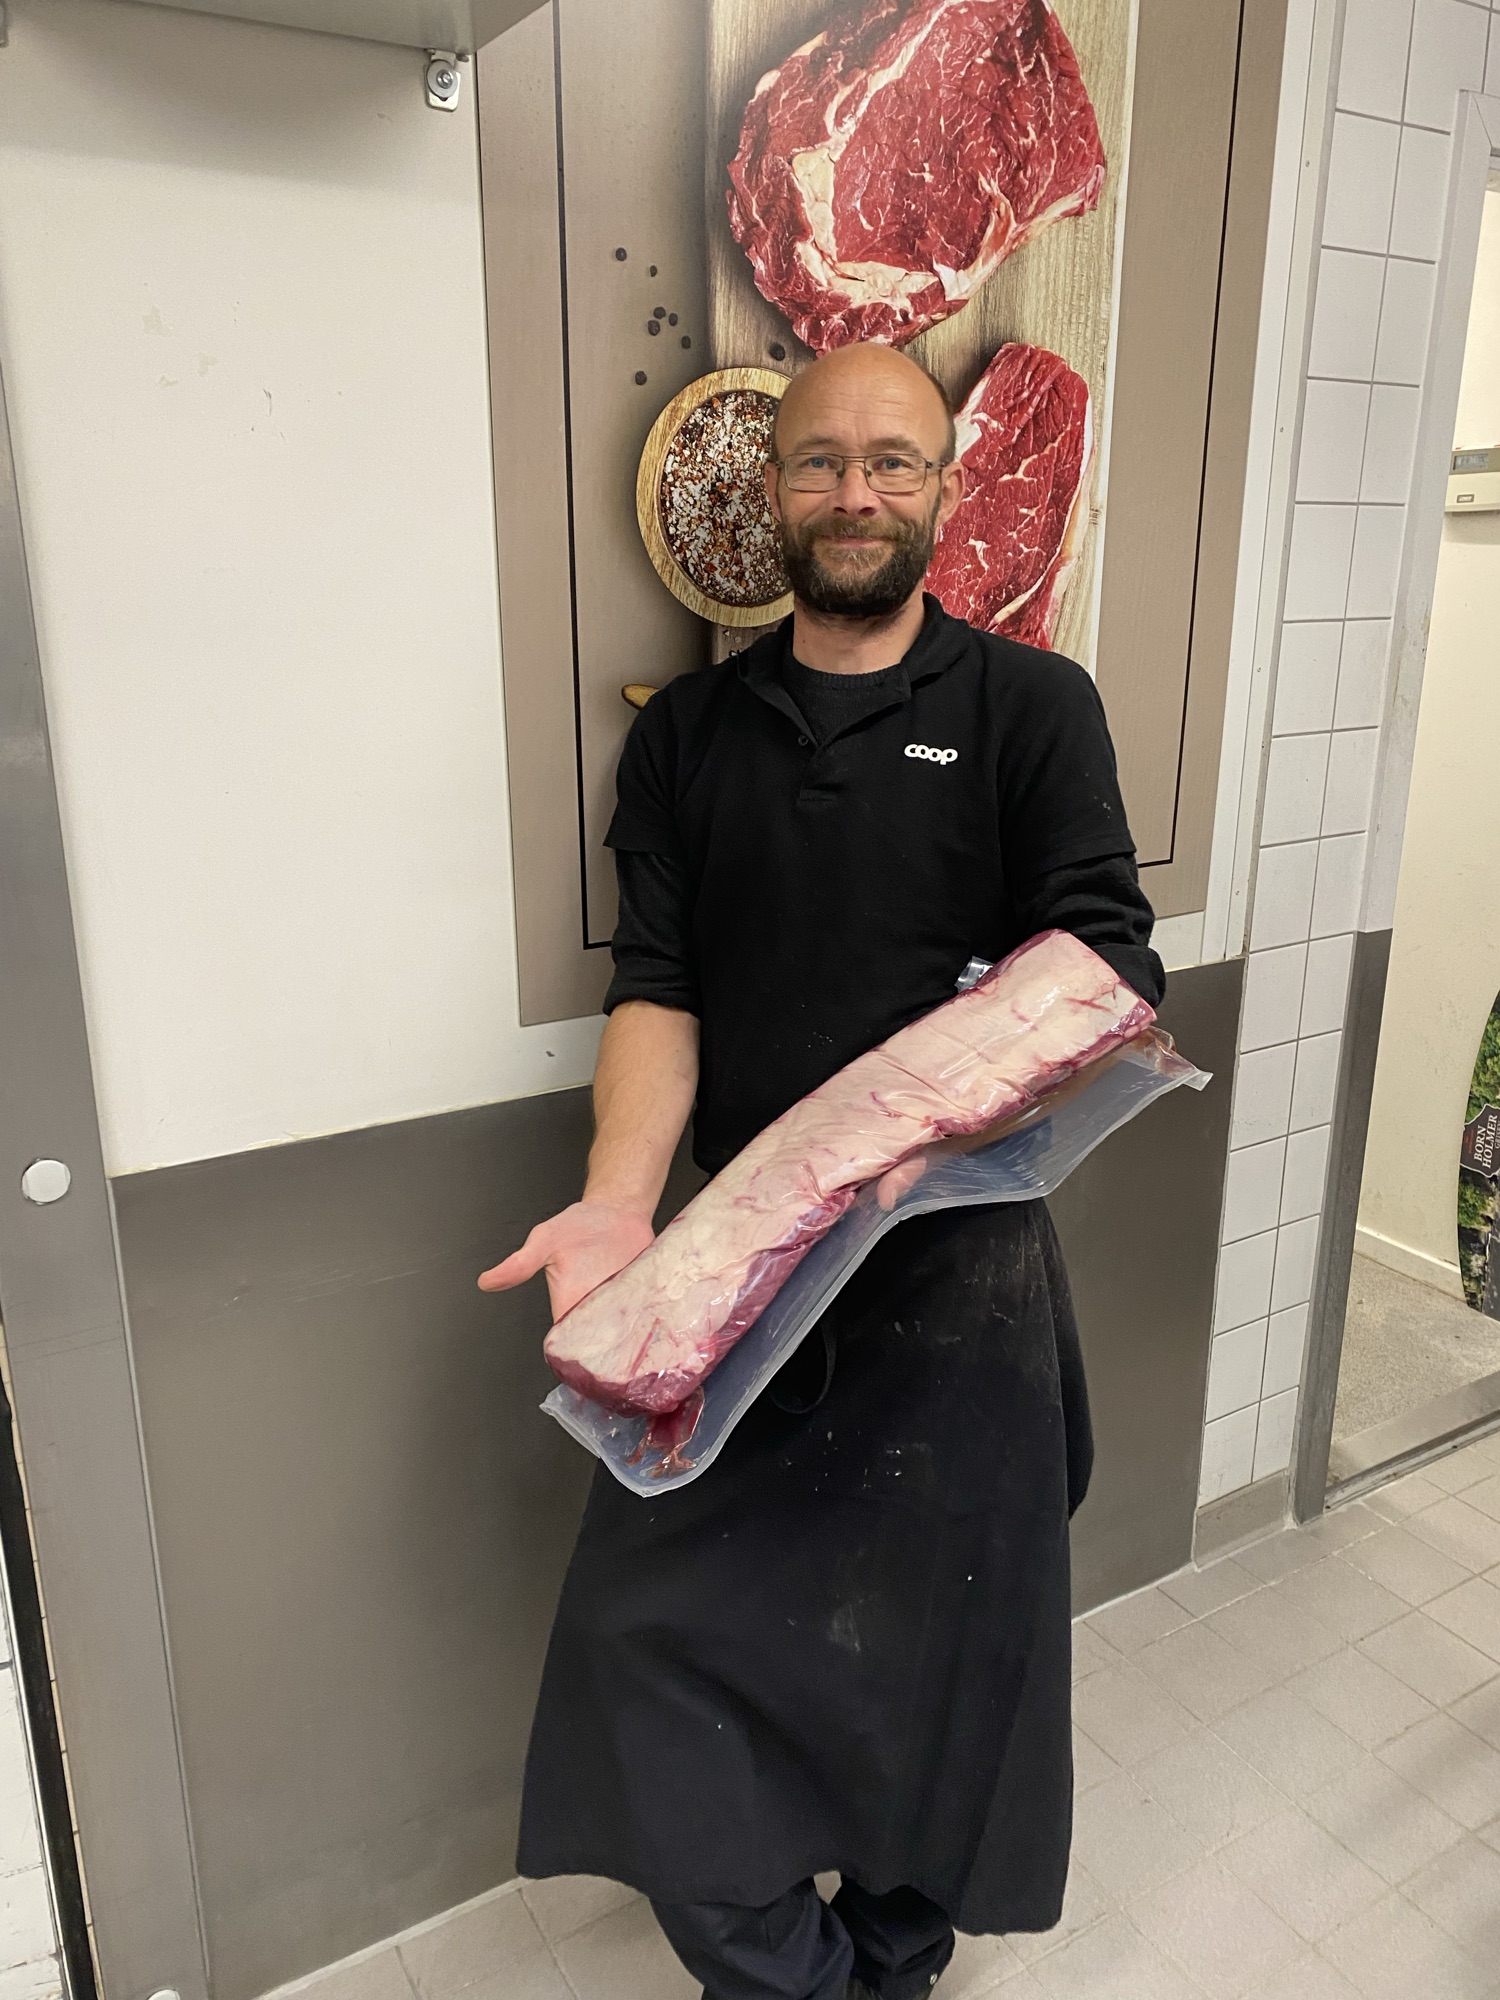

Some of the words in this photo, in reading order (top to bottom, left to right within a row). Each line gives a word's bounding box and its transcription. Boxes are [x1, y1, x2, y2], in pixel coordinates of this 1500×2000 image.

[904, 744, 958, 765] coop
[1474, 1125, 1486, 1162] BORN
[1482, 1115, 1498, 1169] HOLMER
